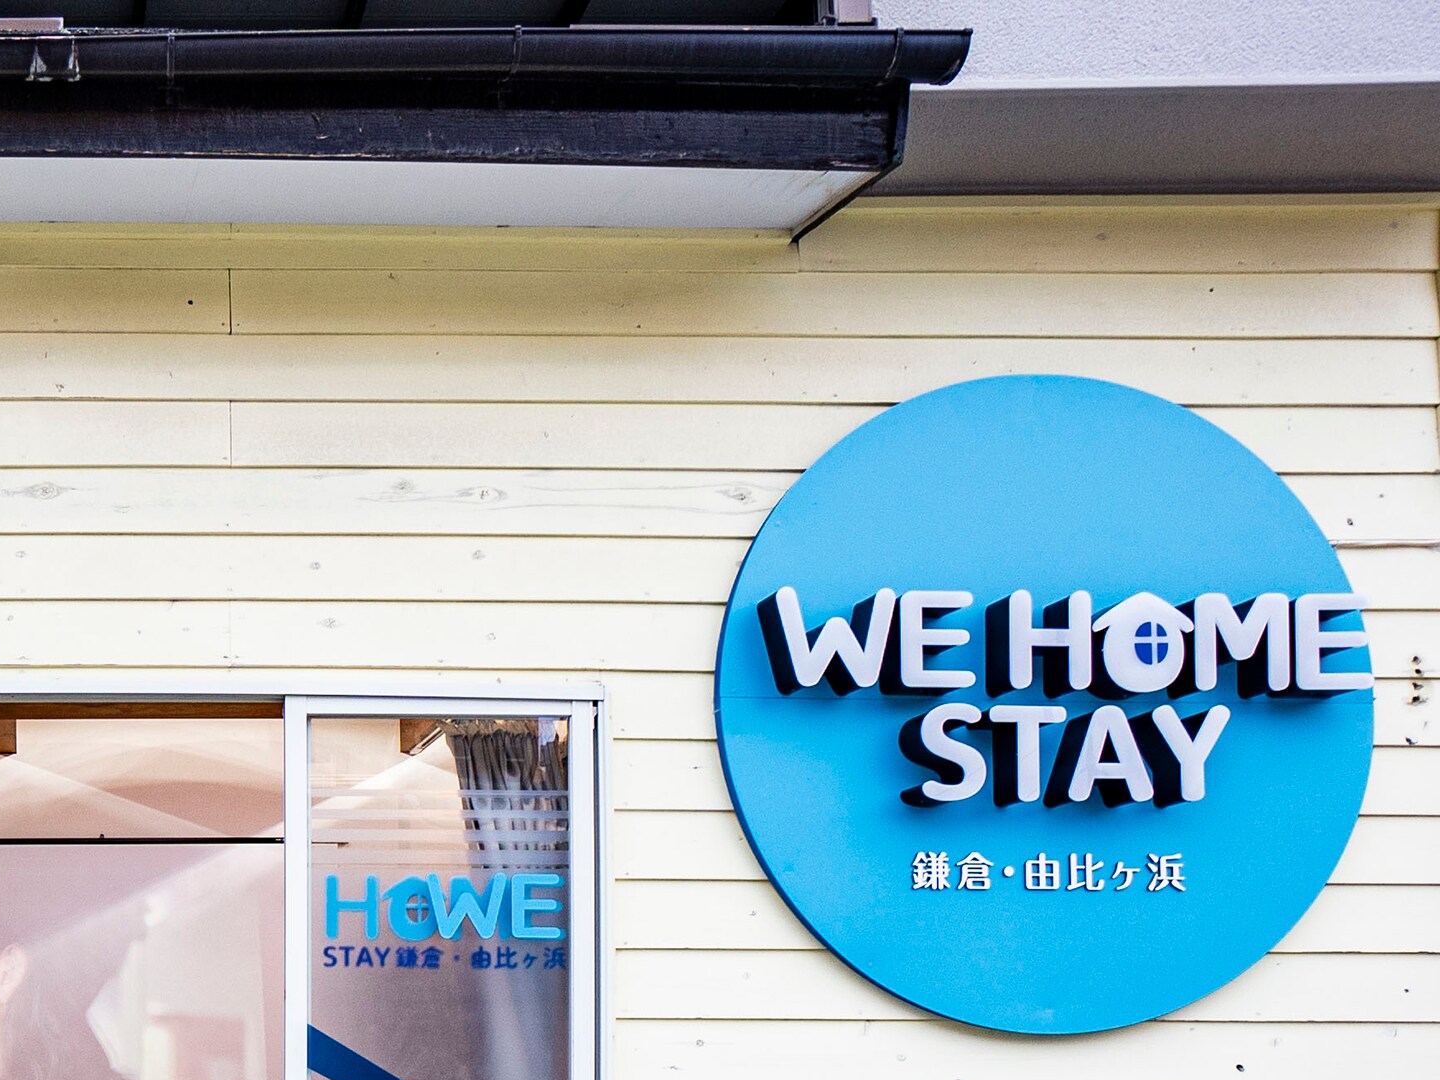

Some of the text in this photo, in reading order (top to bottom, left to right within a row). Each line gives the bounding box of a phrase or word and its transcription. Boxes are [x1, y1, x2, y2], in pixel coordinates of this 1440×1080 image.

[774, 585, 1375, 693] WE HOME
[920, 702, 1232, 803] STAY
[322, 945, 392, 968] STAY
